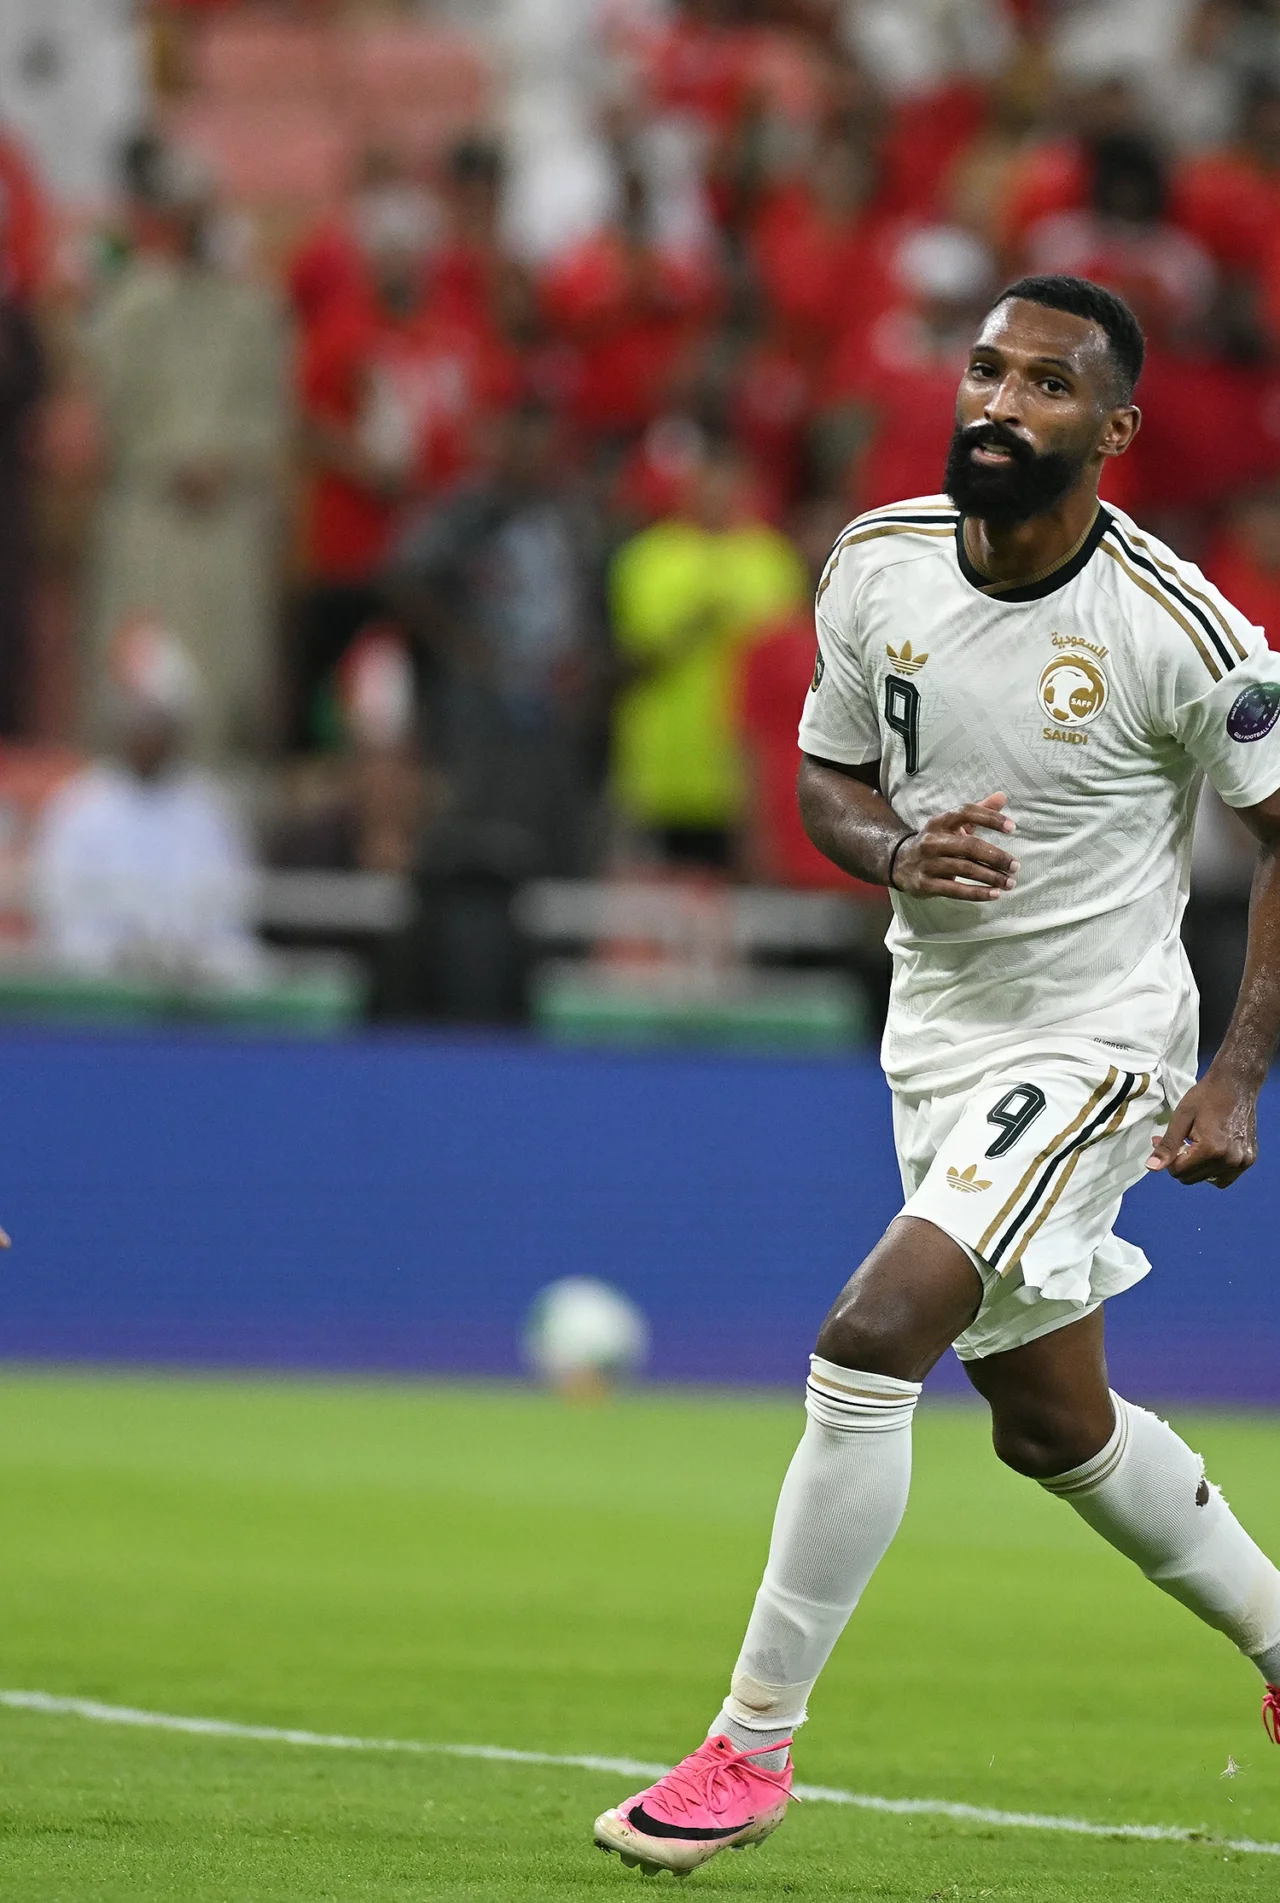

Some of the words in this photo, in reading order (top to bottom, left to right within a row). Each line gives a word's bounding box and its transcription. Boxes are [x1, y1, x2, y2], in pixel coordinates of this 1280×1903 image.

[1051, 631, 1109, 660] السعودية
[1071, 697, 1092, 708] SAFF
[885, 674, 921, 776] 9
[1043, 728, 1089, 745] SAUDI
[1243, 726, 1269, 740] FOOTBALL
[984, 1082, 1047, 1160] 9
